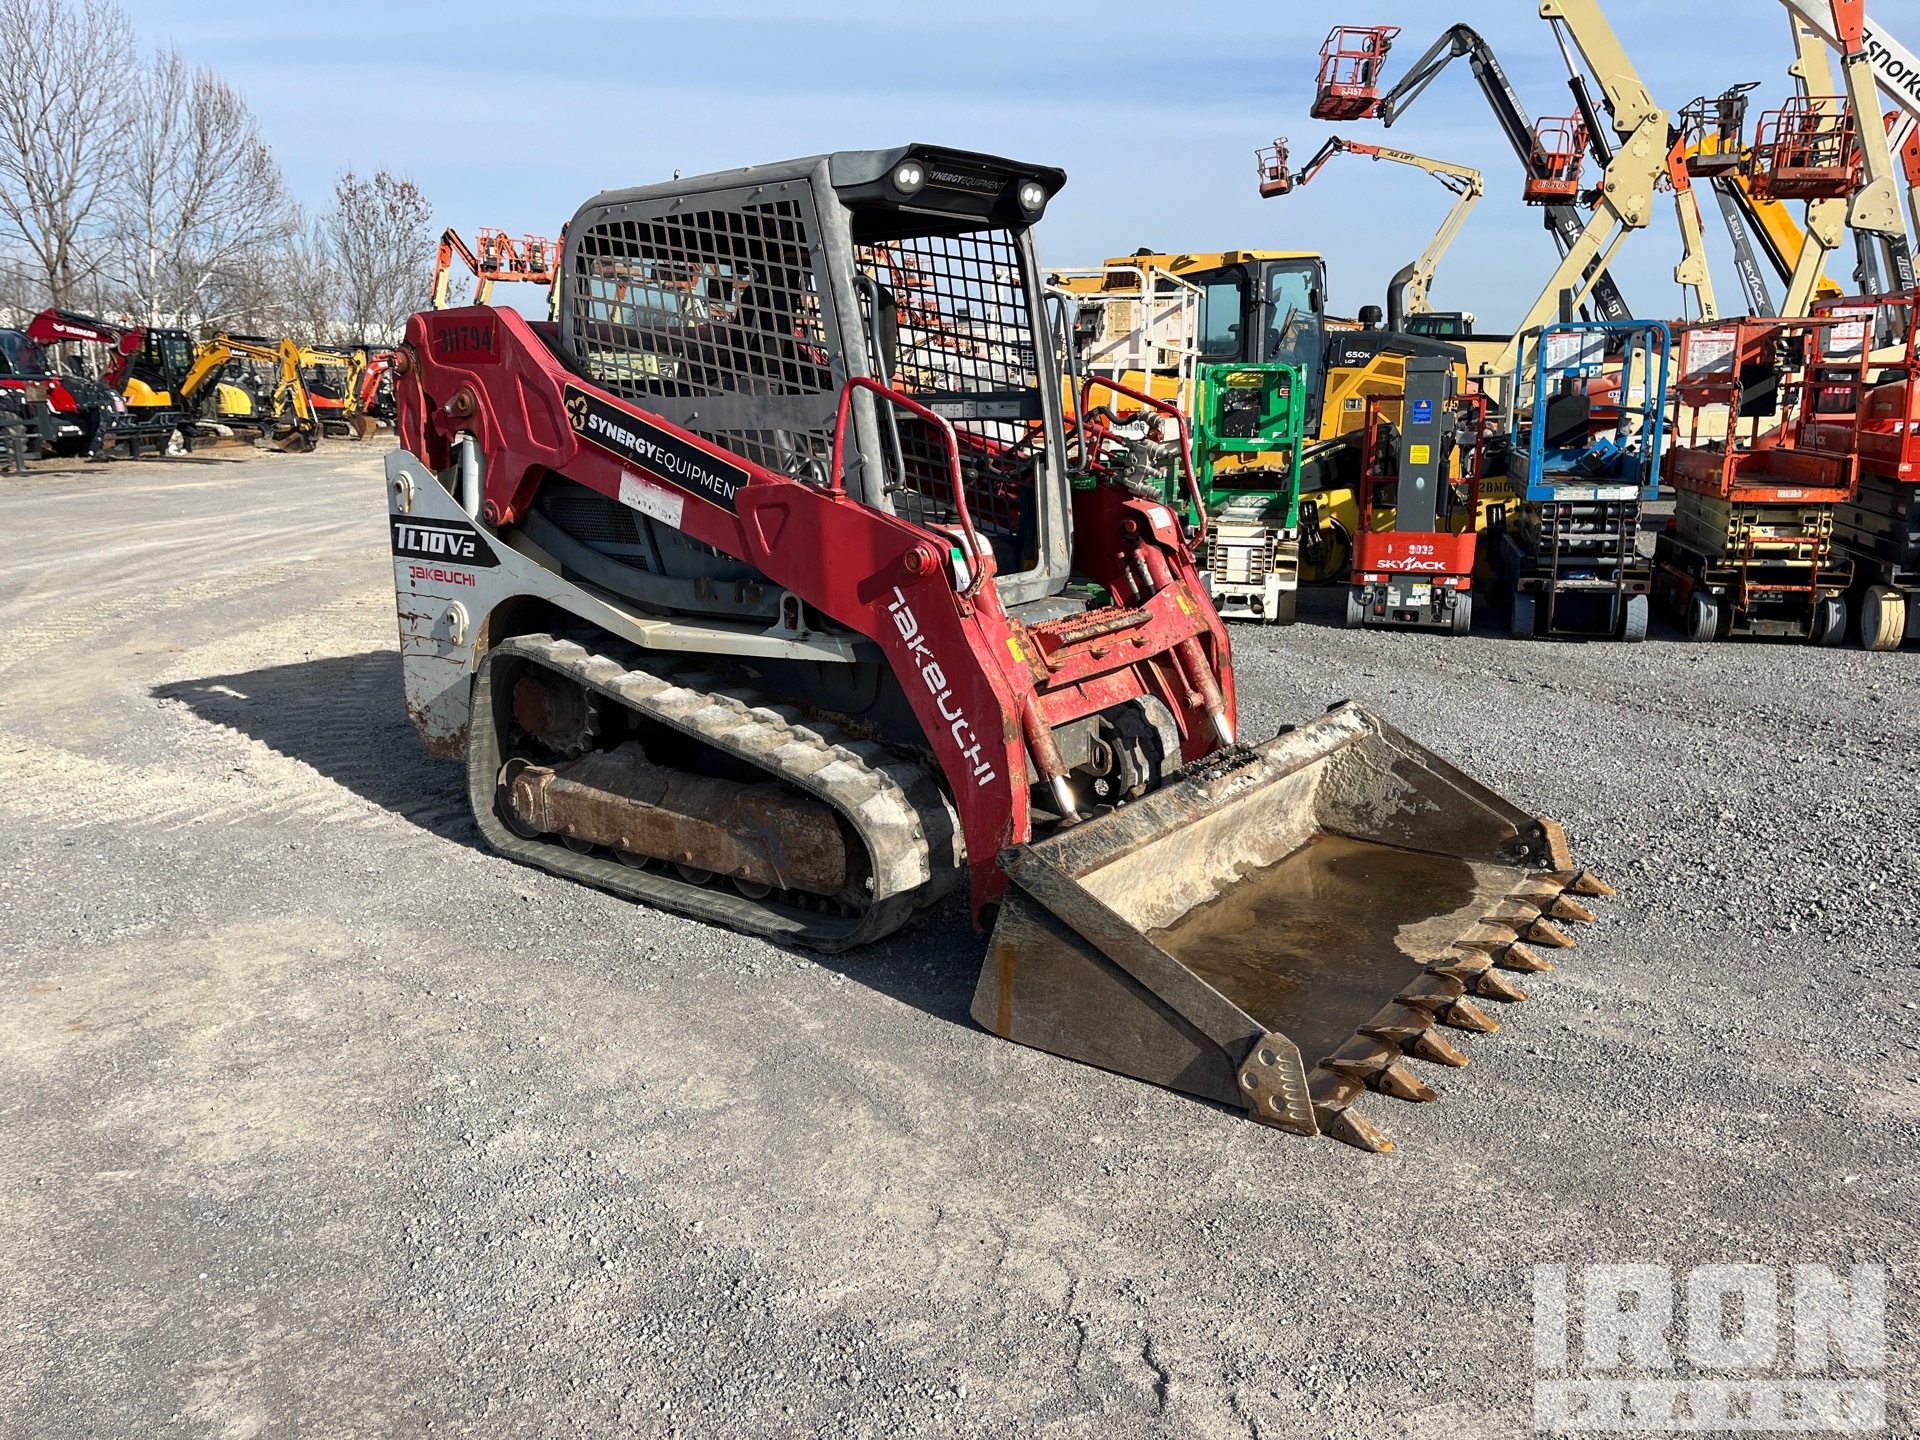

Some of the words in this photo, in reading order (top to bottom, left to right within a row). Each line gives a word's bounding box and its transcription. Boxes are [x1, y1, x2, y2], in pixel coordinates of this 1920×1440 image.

[1341, 88, 1363, 96] SJ45T
[1400, 153, 1415, 161] LIFT
[1743, 259, 1765, 306] SKYJACK
[1601, 288, 1623, 317] SJ45T
[65, 326, 98, 339] YANMAR
[1345, 351, 1371, 359] 650K
[588, 413, 741, 501] SYNERGYEQUIPMEN
[394, 523, 476, 557] TL10V2
[1376, 556, 1446, 571] SKYJACK
